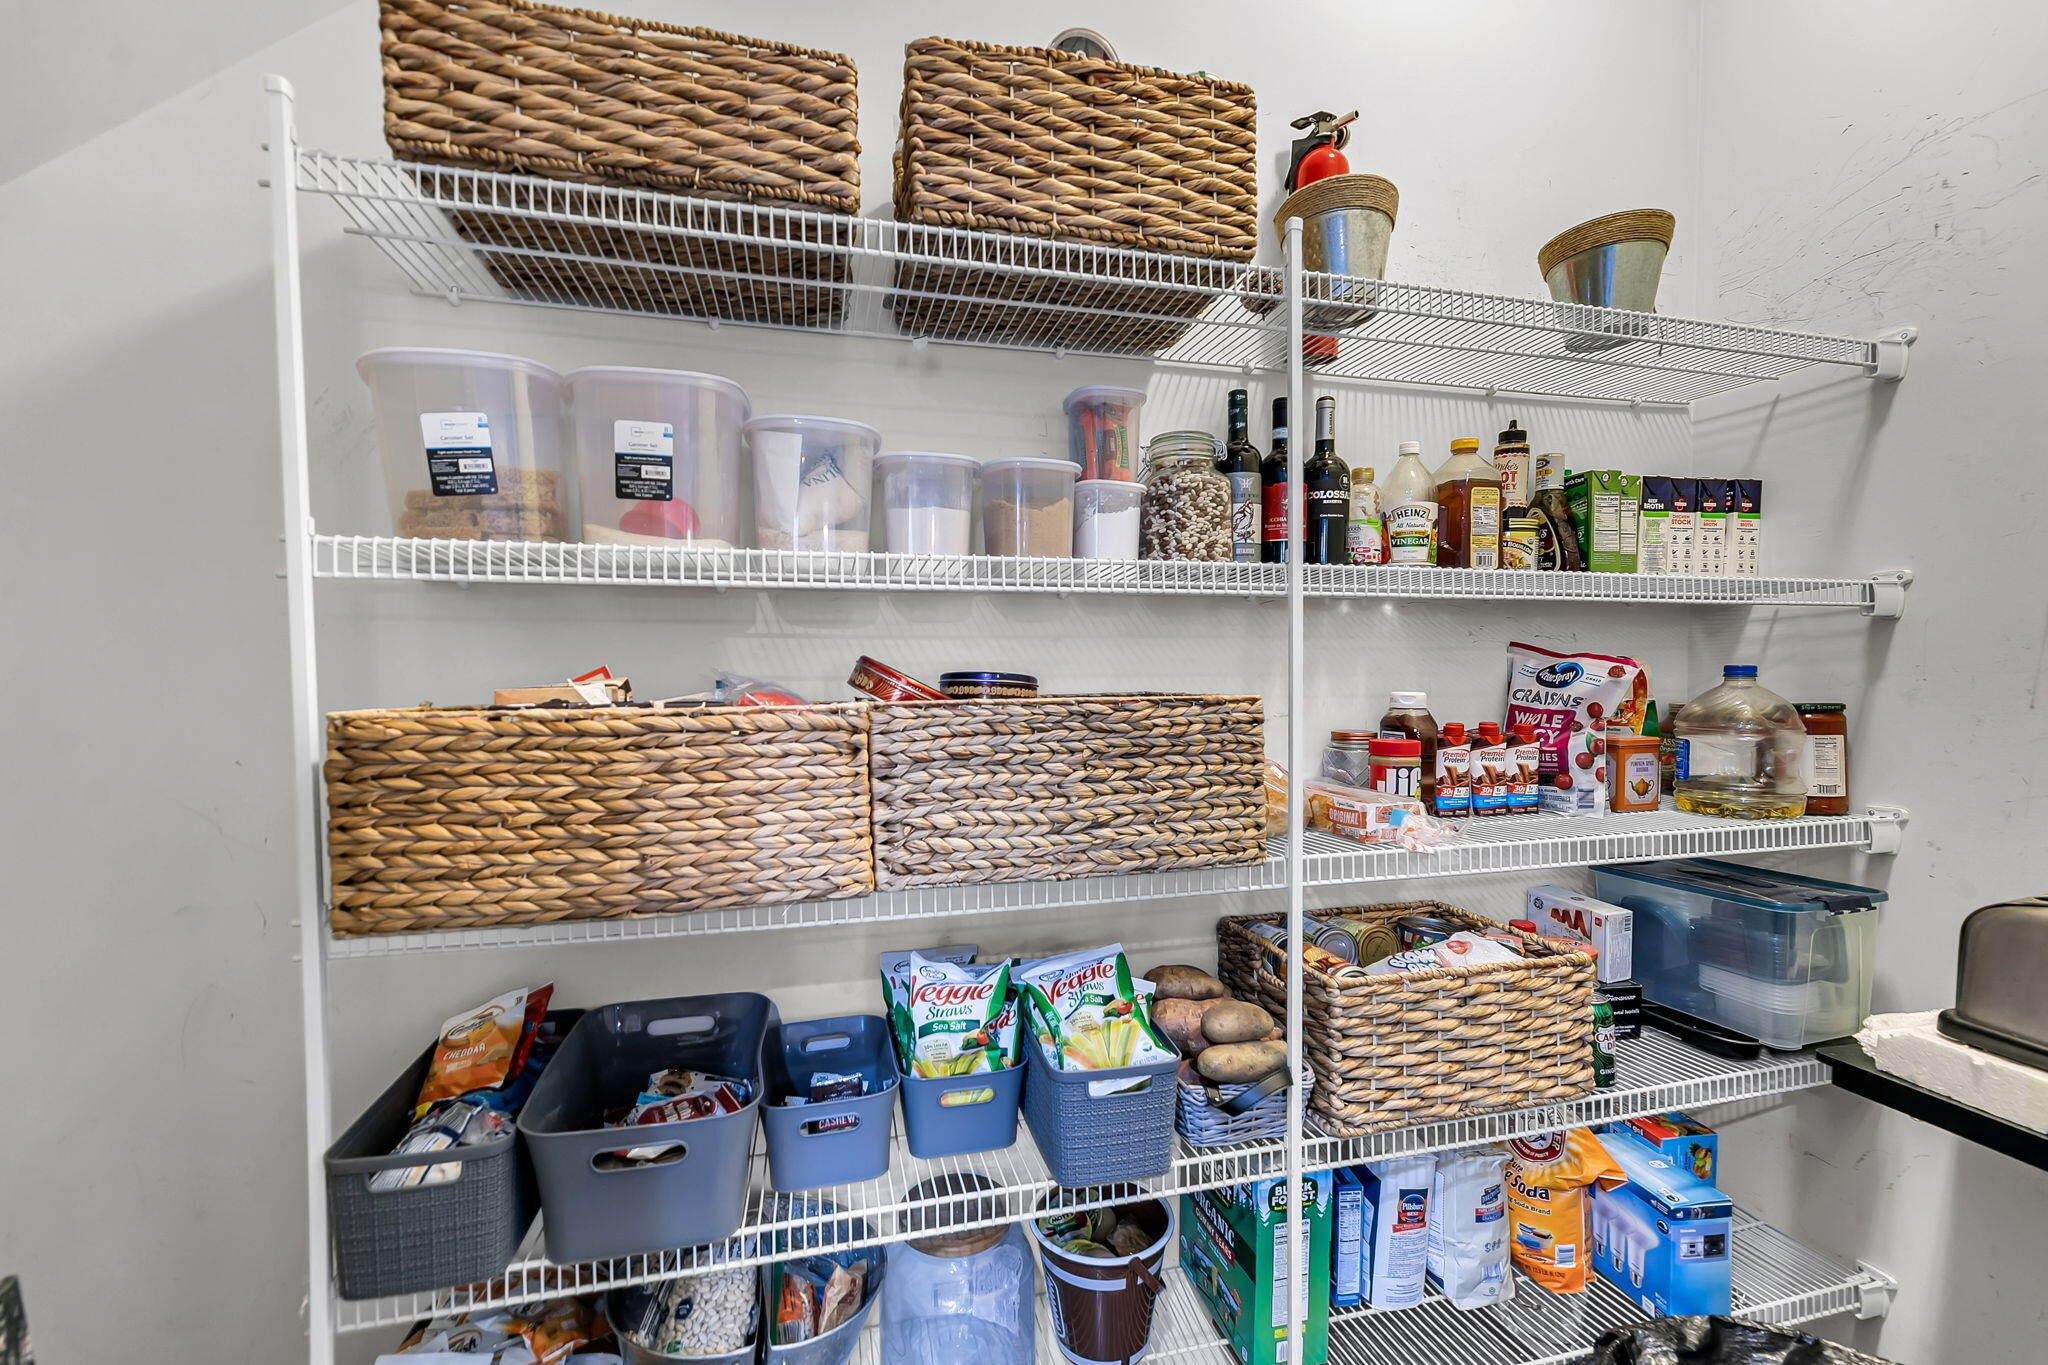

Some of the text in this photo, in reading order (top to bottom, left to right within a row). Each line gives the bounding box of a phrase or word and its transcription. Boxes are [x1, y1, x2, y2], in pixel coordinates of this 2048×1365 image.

[1495, 460, 1518, 470] Mike's
[1501, 471, 1518, 483] OT
[1307, 490, 1351, 500] COLOSSA
[1396, 508, 1427, 520] HEINZ
[1391, 538, 1428, 546] VINEGAR
[1512, 688, 1584, 708] CRAISINS
[1514, 710, 1564, 728] WHOLE
[1376, 768, 1421, 797] Jif
[1329, 808, 1360, 825] ORIGINAL
[911, 976, 993, 1008] Veggie
[1039, 964, 1116, 1006] Veggie
[1068, 982, 1104, 1008] Straws
[1090, 995, 1103, 1003] Salt
[926, 1004, 973, 1020] Straws
[932, 1021, 967, 1032] Sea Salt
[1595, 1033, 1616, 1042] CAN
[443, 1042, 486, 1060] CHEDDAR
[818, 1115, 858, 1129] CASHEW
[1275, 1182, 1312, 1194] BLK
[1510, 1175, 1550, 1200] Soda
[1272, 1192, 1315, 1206] FOST
[1402, 1202, 1424, 1211] Pillsbury
[1513, 1199, 1550, 1215] Soda Brand
[1194, 1191, 1236, 1248] ORGANIC
